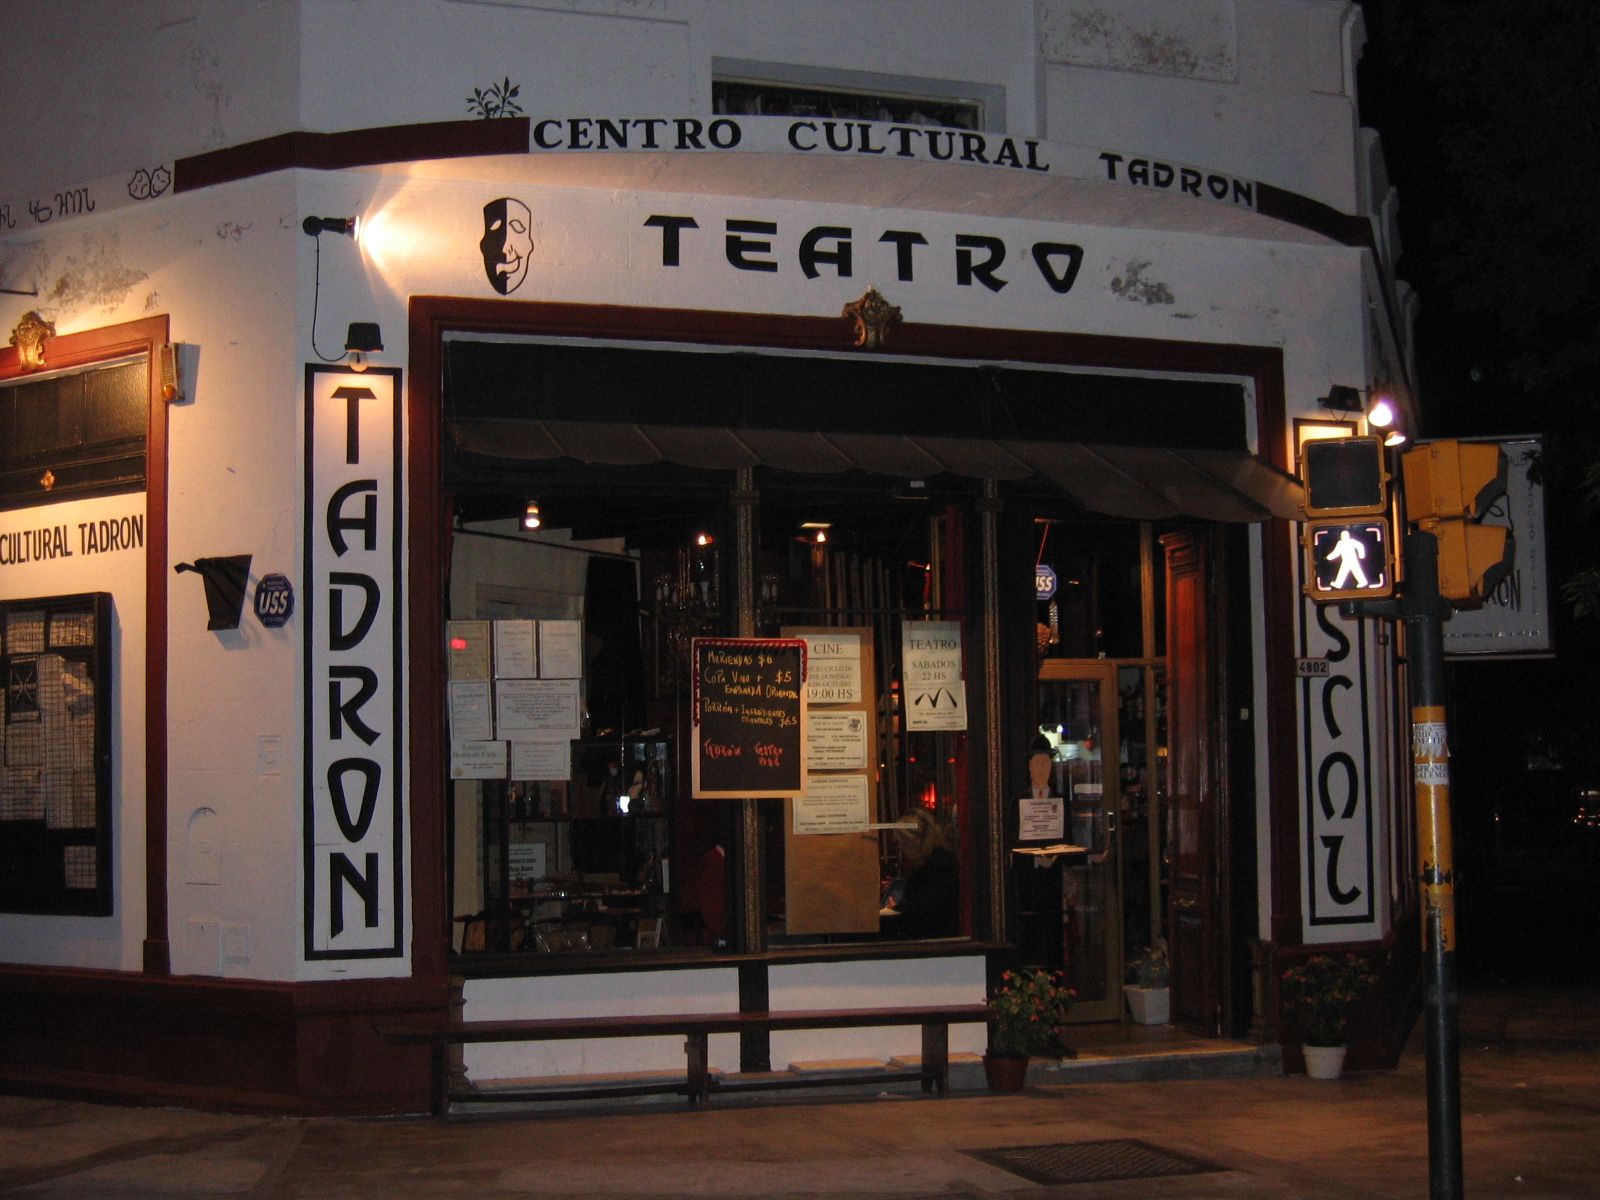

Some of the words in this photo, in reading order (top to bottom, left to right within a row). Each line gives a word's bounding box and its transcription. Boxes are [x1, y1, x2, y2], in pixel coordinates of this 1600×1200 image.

[533, 119, 741, 149] CENTRO
[789, 117, 1050, 172] CULTURAL
[1100, 153, 1253, 207] TADRON
[645, 215, 1084, 293] TEATRO
[0, 525, 72, 566] CULTURAL
[78, 514, 144, 556] TADRON
[259, 591, 288, 615] USS
[814, 644, 843, 654] CINE
[909, 639, 957, 650] TEATRO
[327, 386, 380, 938] TADRON
[1299, 662, 1327, 673] 4802
[775, 669, 792, 684] $5
[922, 672, 932, 681] 22
[934, 672, 946, 681] HS
[838, 688, 853, 698] HS
